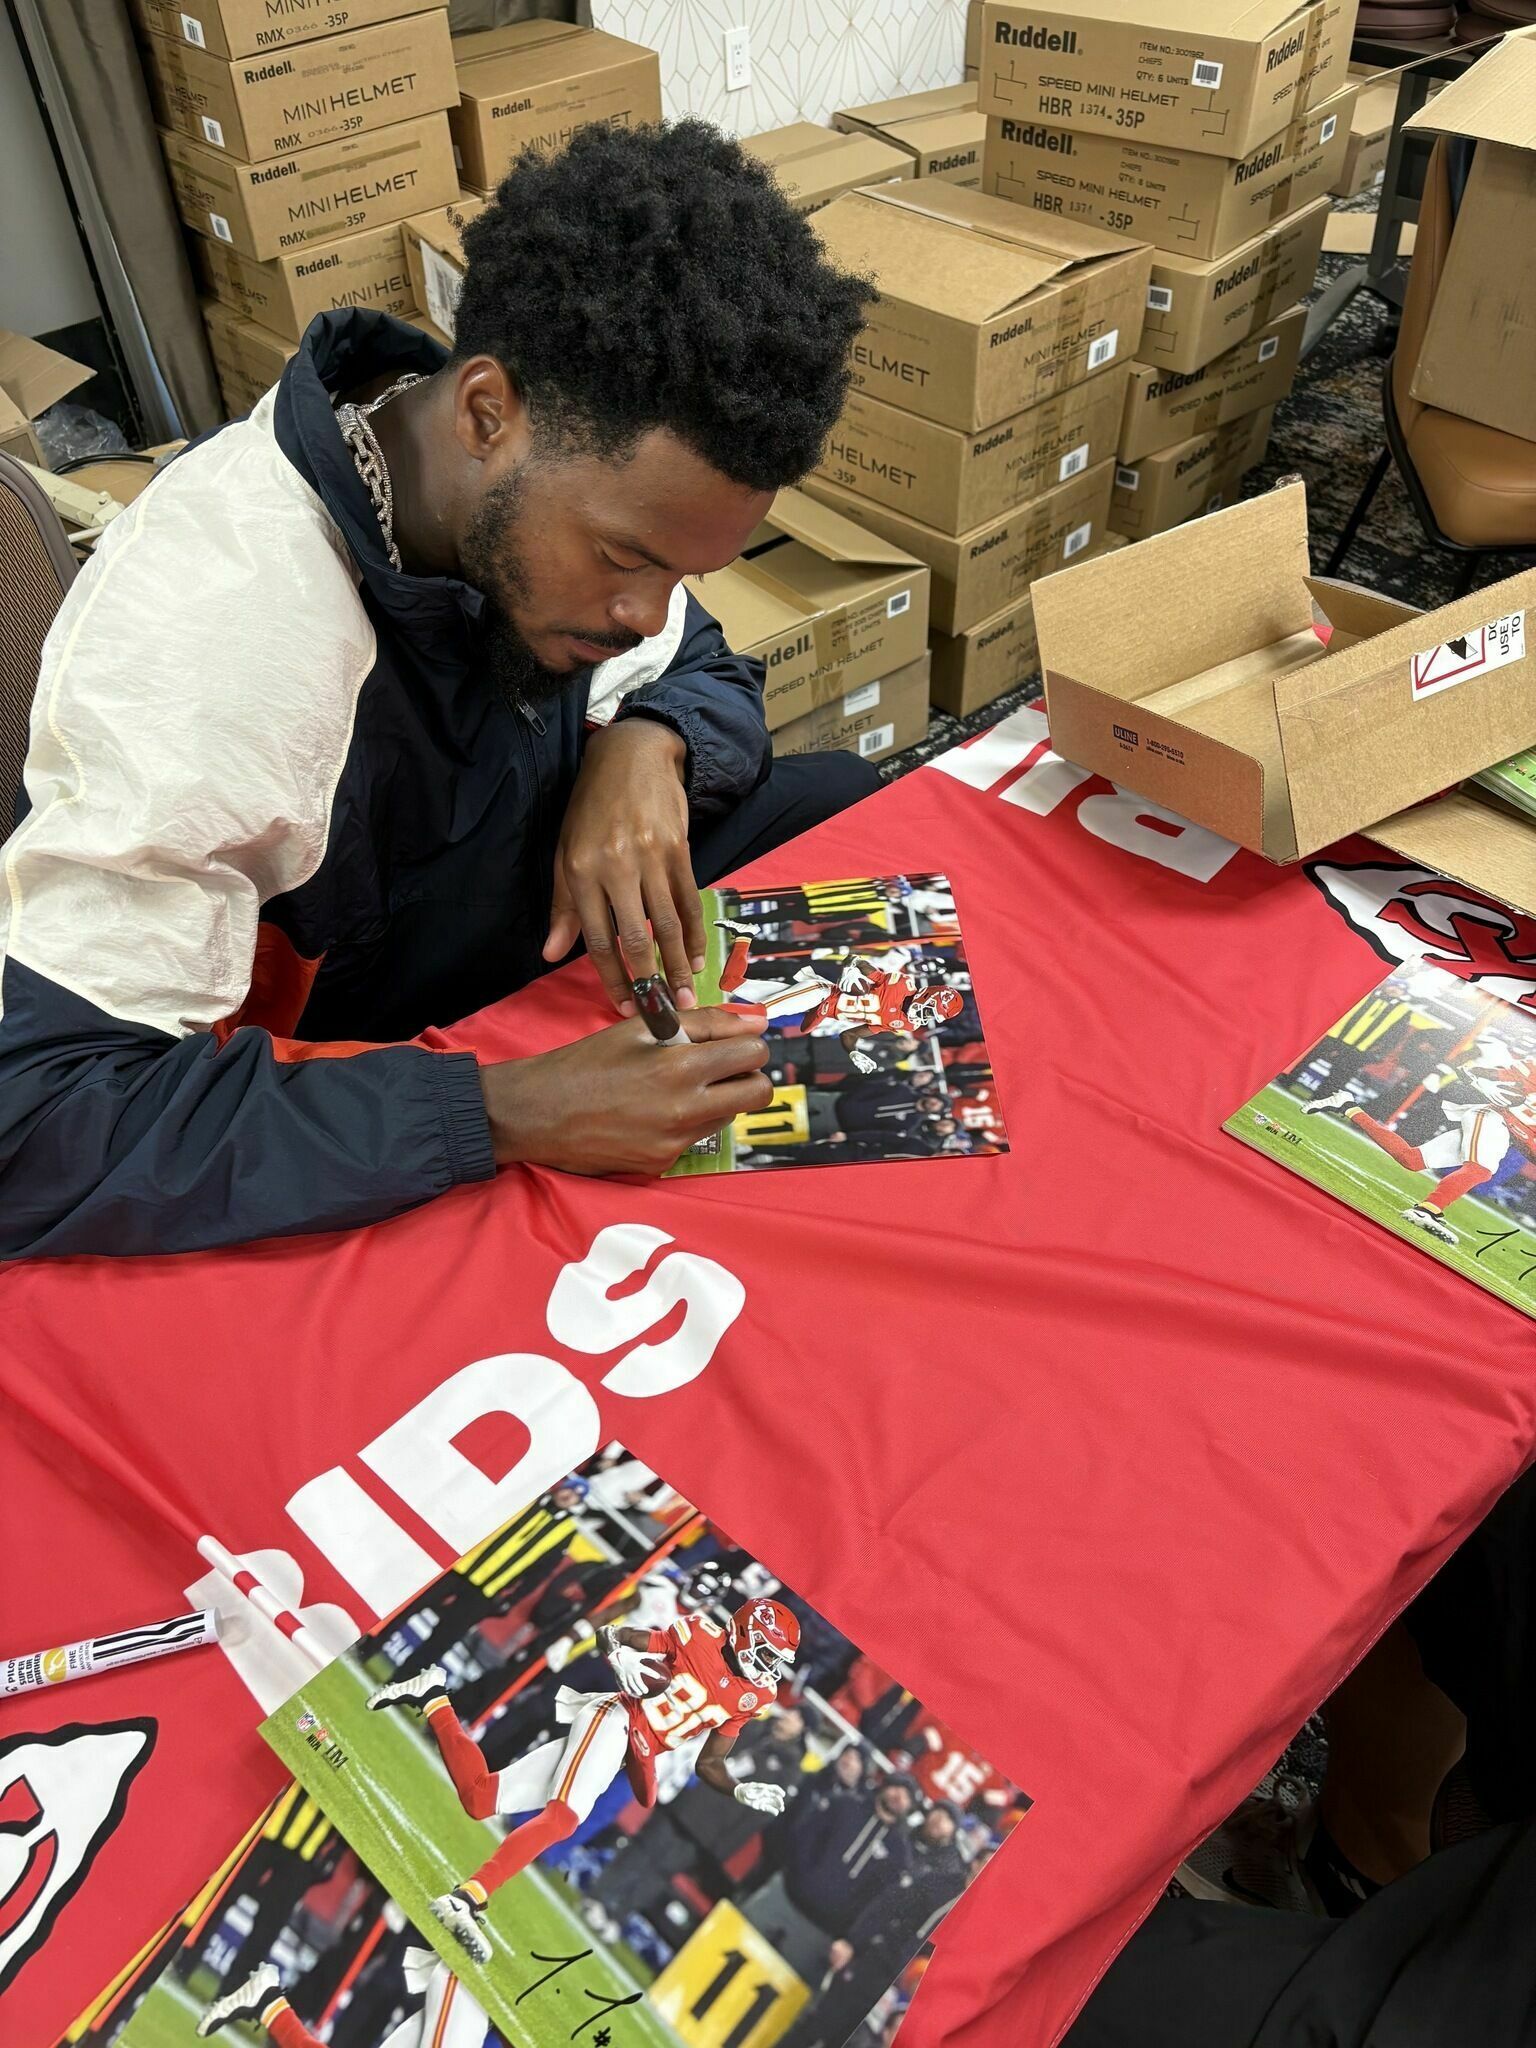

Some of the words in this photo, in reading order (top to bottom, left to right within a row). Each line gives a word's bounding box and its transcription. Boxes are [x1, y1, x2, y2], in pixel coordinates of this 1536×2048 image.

[256, 28, 285, 46] RMX
[324, 12, 349, 28] -35P
[994, 21, 1077, 54] Riddell
[1139, 42, 1158, 52] ITEM
[1265, 28, 1305, 73] Riddell
[244, 60, 295, 84] Riddell
[1136, 70, 1155, 82] QTY:
[1166, 75, 1189, 86] UNITS
[283, 98, 327, 124] MINI
[330, 73, 417, 111] HELMET
[1037, 75, 1082, 92] SPEED
[1086, 83, 1115, 98] MINI
[1120, 89, 1180, 107] HELMET
[1038, 95, 1072, 117] HBR
[1079, 103, 1106, 118] 1374
[492, 98, 534, 119] Riddell
[274, 133, 302, 150] RMX
[339, 115, 363, 132] -35P
[1001, 120, 1073, 155] Riddell
[250, 161, 300, 185] Riddell
[928, 151, 976, 174] Riddell
[1234, 143, 1283, 186] Riddell
[288, 197, 331, 223] MINI
[335, 169, 418, 210] HELMET
[1033, 191, 1063, 214] HBR
[1036, 169, 1076, 188] SPEED
[1079, 179, 1105, 196] MINI
[1108, 188, 1161, 210] HELMET
[279, 230, 306, 248] RMX
[344, 211, 366, 228] -35P
[295, 254, 342, 277] Riddell
[1213, 255, 1260, 301] Riddell
[331, 286, 372, 310] MINI
[374, 276, 412, 298] HEL
[990, 317, 1032, 348] Riddell
[1052, 319, 1105, 355] HELMET
[852, 345, 931, 387] ELMET
[973, 427, 1013, 458] Riddell
[831, 440, 917, 489] HELMET
[969, 529, 1008, 560] Riddell
[1500, 623, 1510, 655] USE
[1511, 615, 1521, 637] TO
[766, 676, 805, 702] SPEED
[808, 661, 833, 681] MINI
[836, 638, 884, 667] HELMET
[809, 714, 874, 750] HELMET
[1114, 726, 1137, 744] ULINE
[962, 1107, 996, 1127] 15
[17, 1660, 27, 1685] SUPER
[25, 1658, 35, 1684] COLOR
[33, 1652, 45, 1685] MARKER
[69, 1649, 77, 1669] FINE
[931, 1751, 985, 1806] 15
[691, 1949, 780, 2048] 11
